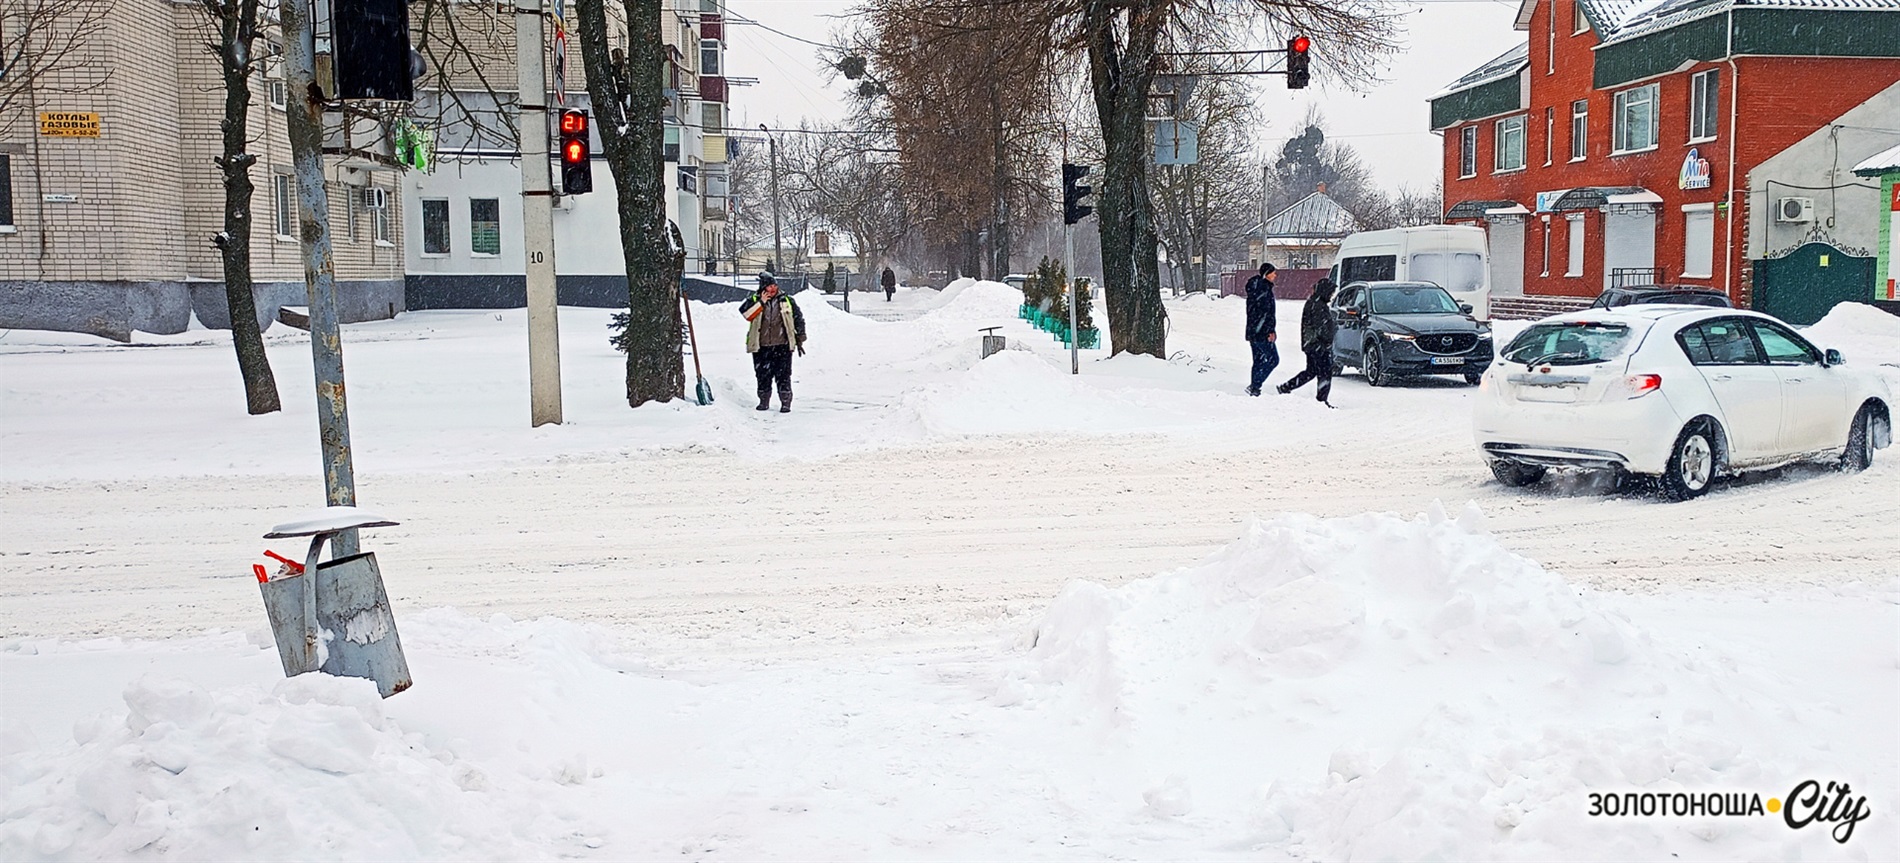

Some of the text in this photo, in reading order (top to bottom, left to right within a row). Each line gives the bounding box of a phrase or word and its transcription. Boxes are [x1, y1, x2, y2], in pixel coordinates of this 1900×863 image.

[48, 113, 90, 121] КОТЛЫ
[41, 121, 97, 129] ГАЗОВЫЕ
[564, 115, 583, 130] 21
[1685, 179, 1710, 188] SERVICE
[531, 251, 544, 264] 10
